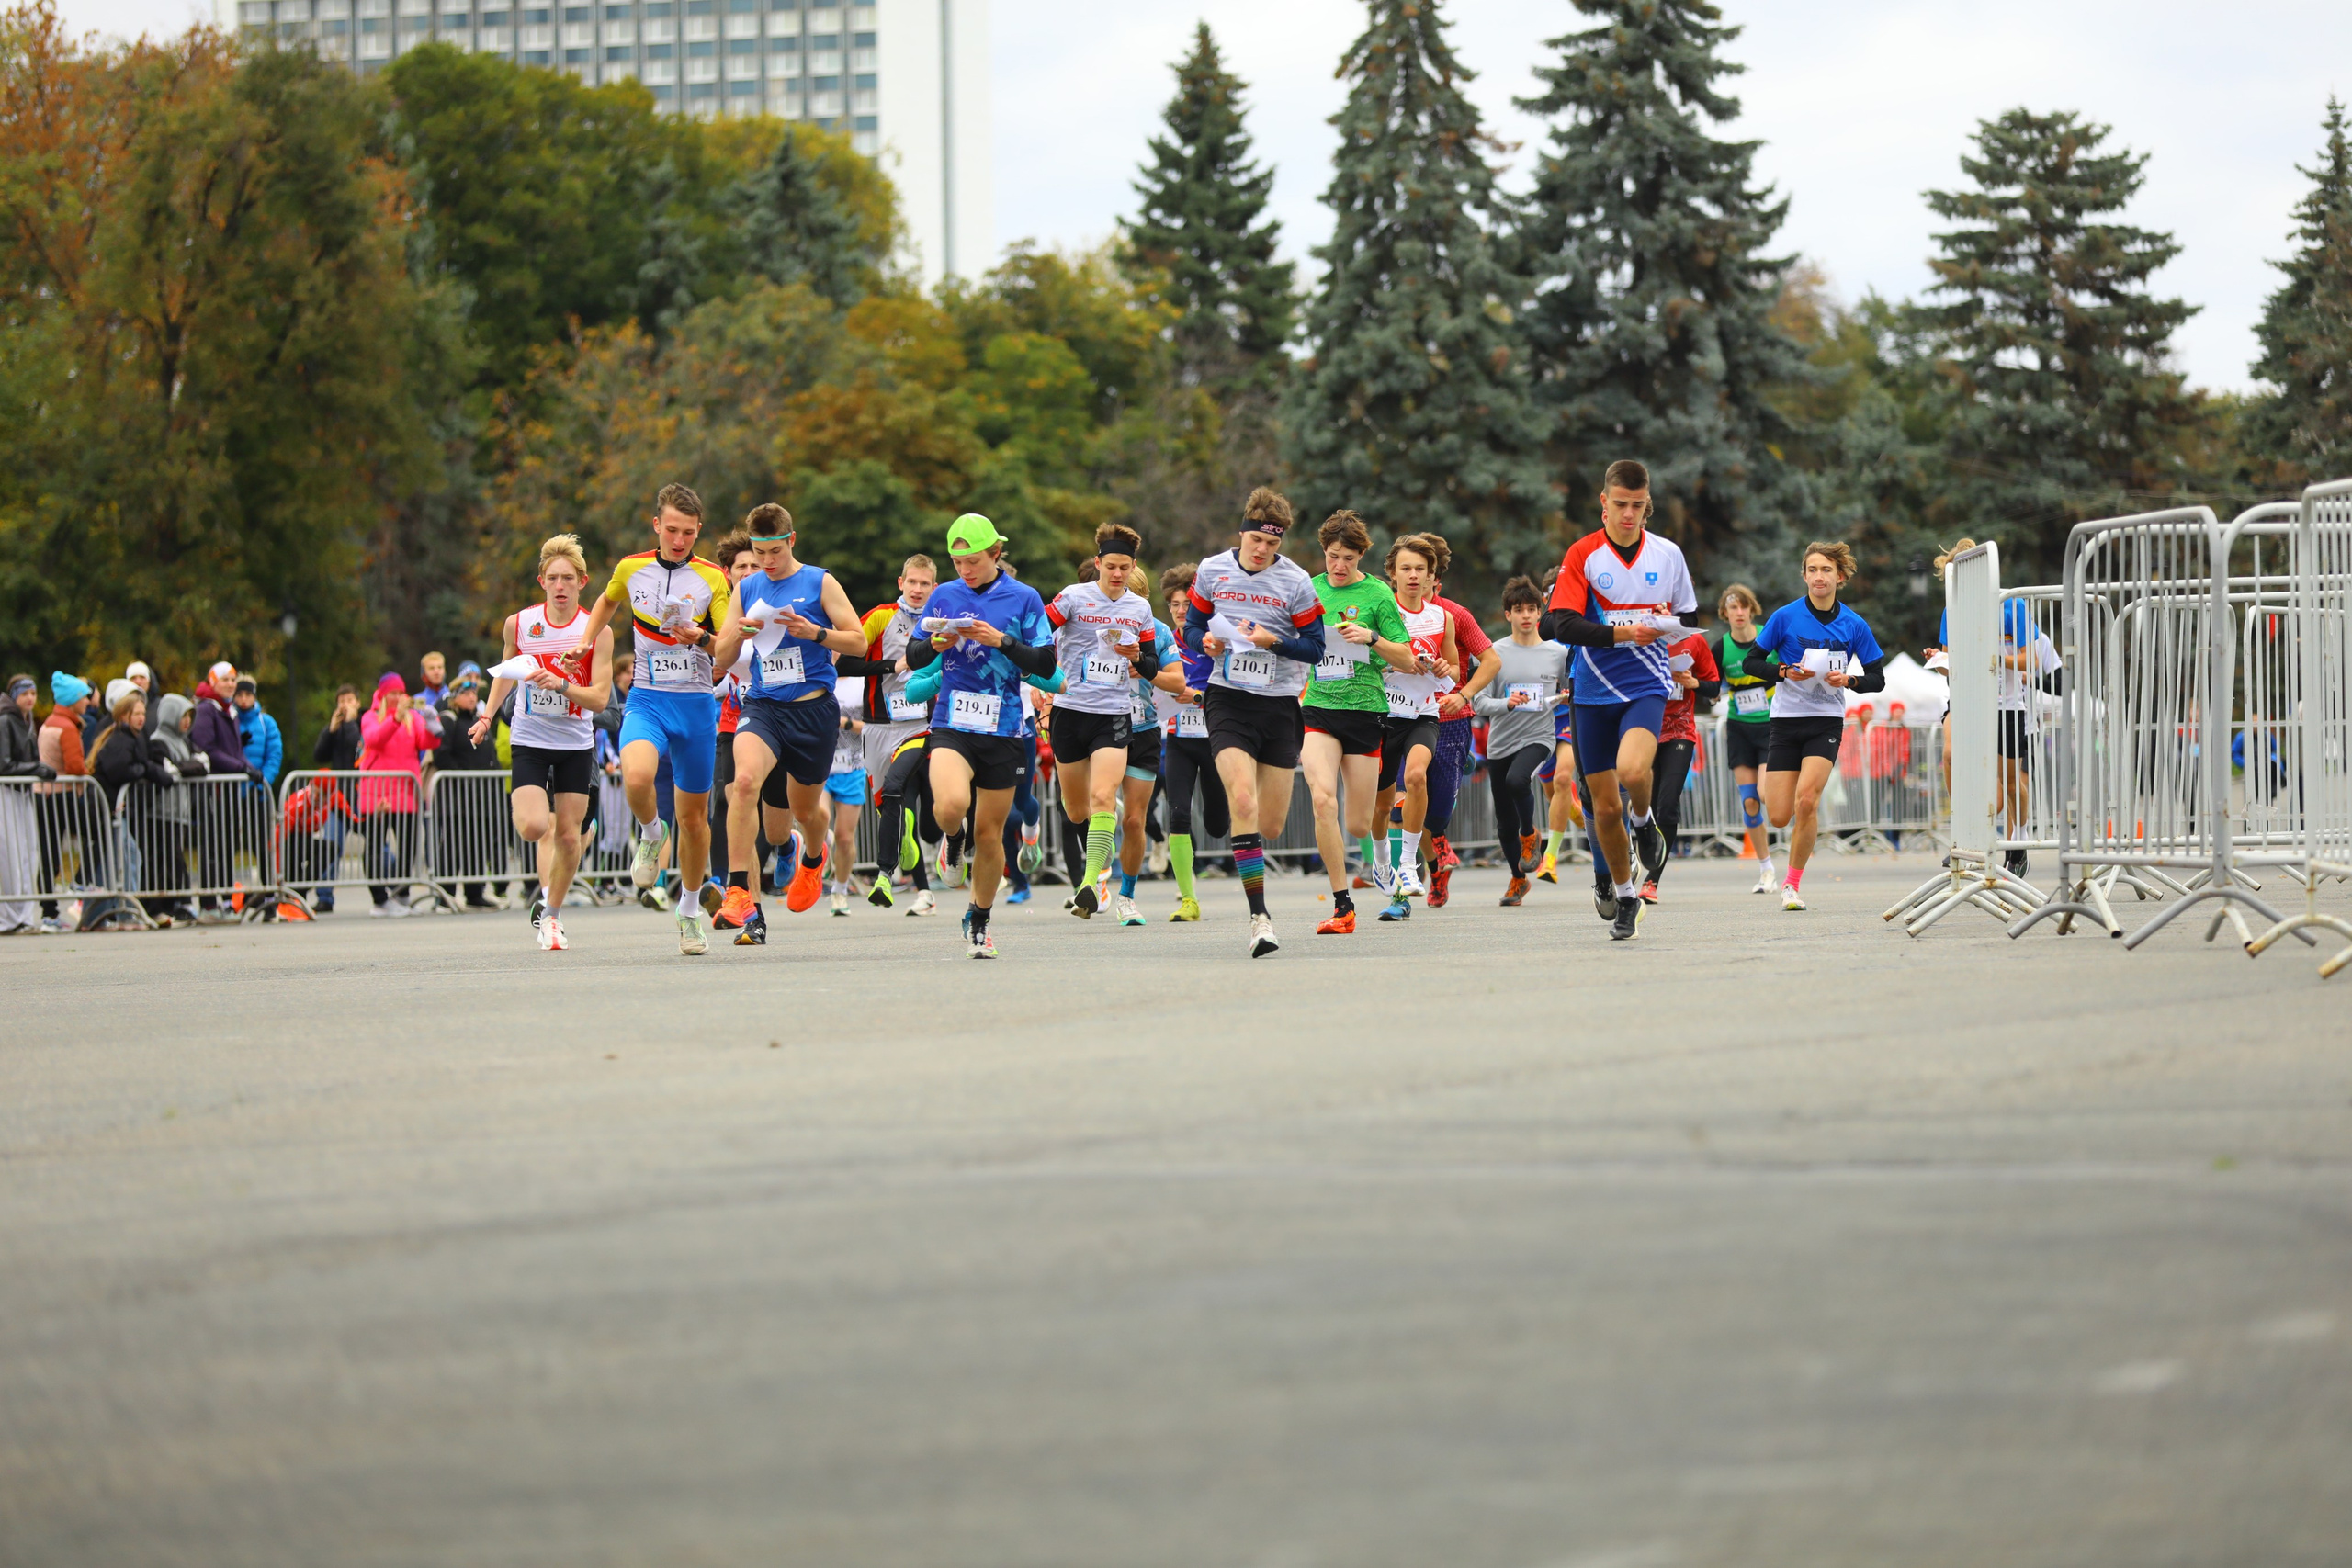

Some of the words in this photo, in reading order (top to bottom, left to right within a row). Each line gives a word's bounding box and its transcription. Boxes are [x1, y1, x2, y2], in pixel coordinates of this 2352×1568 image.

[1213, 591, 1247, 602] NORD
[1250, 594, 1288, 609] WEST
[1078, 615, 1112, 625] NORD
[1115, 617, 1144, 628] WEST
[654, 659, 689, 671] 236.1
[763, 657, 795, 672] 220.1
[1089, 661, 1119, 675] 216.1
[1232, 658, 1269, 675] 210.1
[533, 694, 563, 705] 229.1
[1385, 692, 1414, 707] 209.1
[1737, 694, 1759, 705] 221.1
[956, 699, 991, 716] 219.1
[1181, 716, 1206, 726] 213.1
